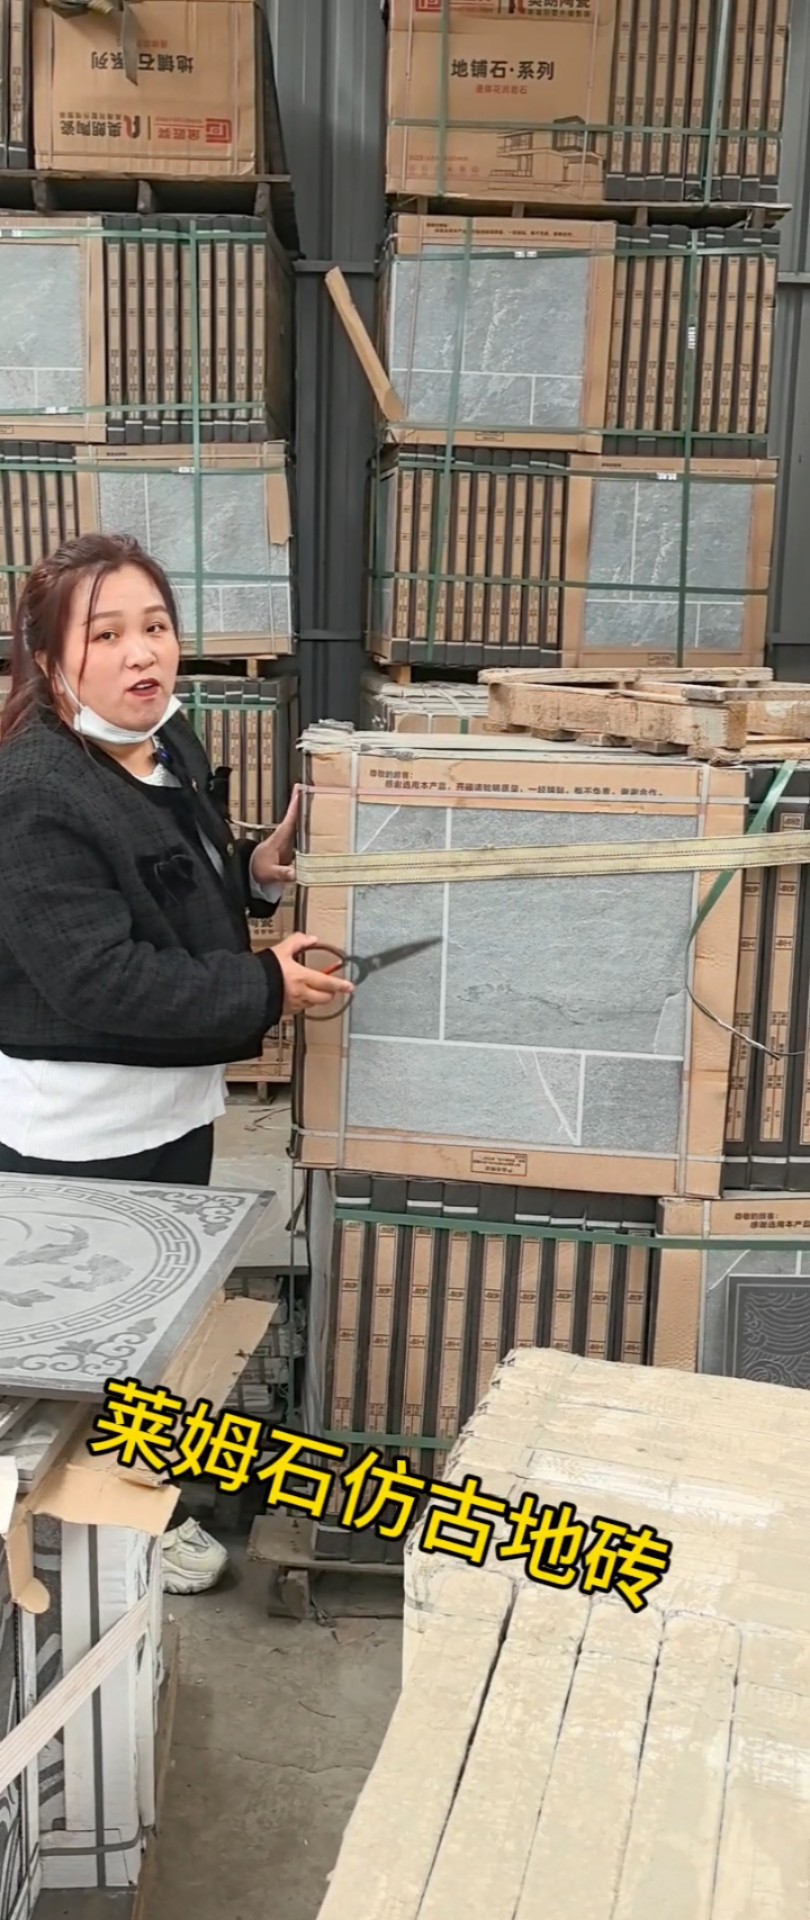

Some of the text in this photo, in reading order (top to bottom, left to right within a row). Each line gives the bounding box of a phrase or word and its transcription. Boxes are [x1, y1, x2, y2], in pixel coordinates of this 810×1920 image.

[91, 51, 194, 73] 地铺石系列
[60, 120, 122, 138] 奥朗陶瓷
